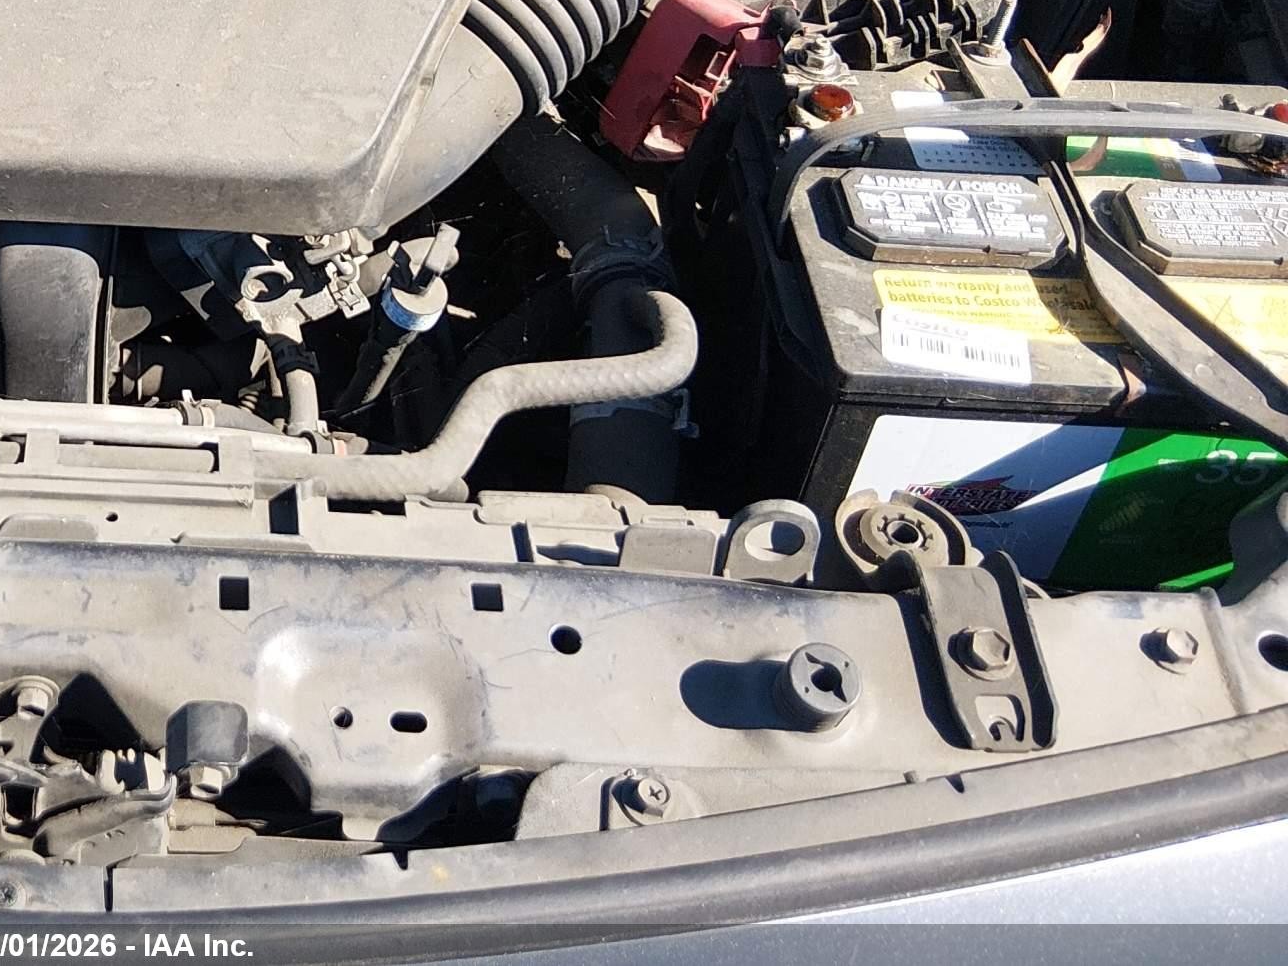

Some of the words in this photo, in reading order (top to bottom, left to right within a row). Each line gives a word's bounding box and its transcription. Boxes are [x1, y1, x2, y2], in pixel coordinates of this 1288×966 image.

[876, 175, 943, 191] DANGER
[960, 180, 1023, 194] POISON
[884, 276, 931, 288] Return
[935, 280, 1001, 294] warranty
[1004, 280, 1032, 293] and
[888, 291, 953, 305] batteries
[955, 294, 970, 306] to
[973, 295, 1021, 308] Costco
[1194, 449, 1279, 486] 35
[908, 484, 1033, 501] INTERSTATE
